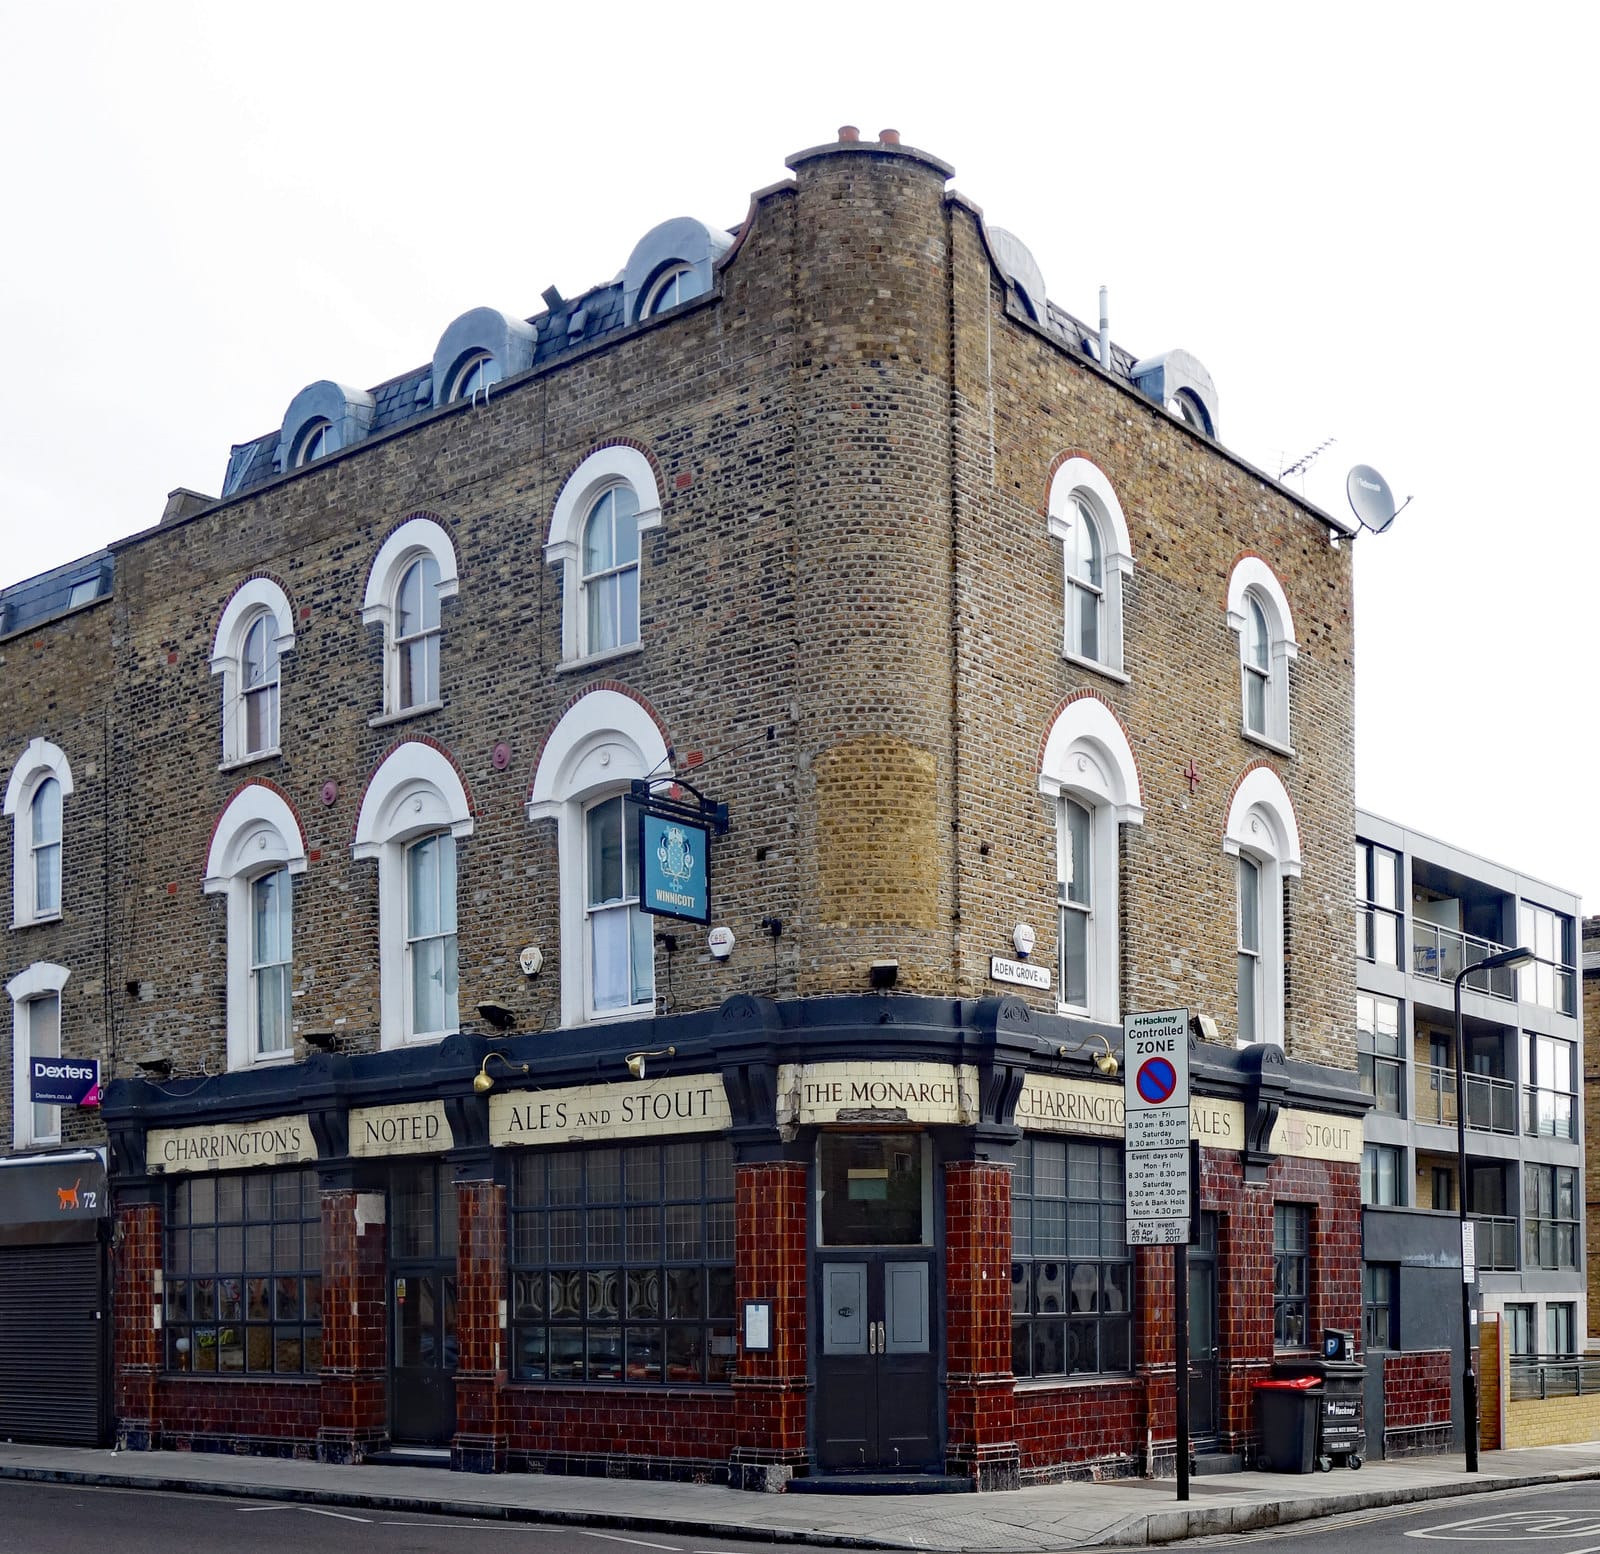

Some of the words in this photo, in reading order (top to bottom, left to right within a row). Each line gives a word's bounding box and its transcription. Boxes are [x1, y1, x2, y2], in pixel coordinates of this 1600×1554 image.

[656, 889, 695, 908] WINNICOTT
[994, 962, 1014, 977] ADEN
[1016, 966, 1038, 982] GROVE
[1142, 1016, 1178, 1025] Hackney
[1129, 1025, 1184, 1039] Controlled
[1136, 1040, 1176, 1055] ZONE
[34, 1063, 93, 1080] Dexters
[35, 1092, 73, 1101] Dexters.co.uk
[804, 1082, 842, 1103] THE
[851, 1082, 954, 1104] MONARCH
[507, 1103, 568, 1132] ALES
[576, 1110, 610, 1127] AND
[622, 1089, 713, 1123] STOUT
[365, 1114, 440, 1143] NOTED
[1159, 1120, 1175, 1128] 6.30
[1190, 1109, 1232, 1136] ALES
[1142, 1130, 1172, 1138] Saturday
[1305, 1123, 1351, 1150] STOUT
[164, 1127, 301, 1161] CHARRINGTON'S
[1160, 1138, 1175, 1146] 1.30
[1175, 1138, 1186, 1146] pm
[1152, 1152, 1168, 1160] days
[1169, 1151, 1184, 1159] only
[1142, 1181, 1172, 1189] Saturday
[1159, 1188, 1176, 1196] 4.30
[83, 1191, 97, 1209] 72
[1133, 1208, 1150, 1216] Noon
[1154, 1207, 1171, 1215] 4.30
[1131, 1235, 1140, 1243] 07
[1141, 1235, 1154, 1243] May
[1165, 1235, 1180, 1243] 2017
